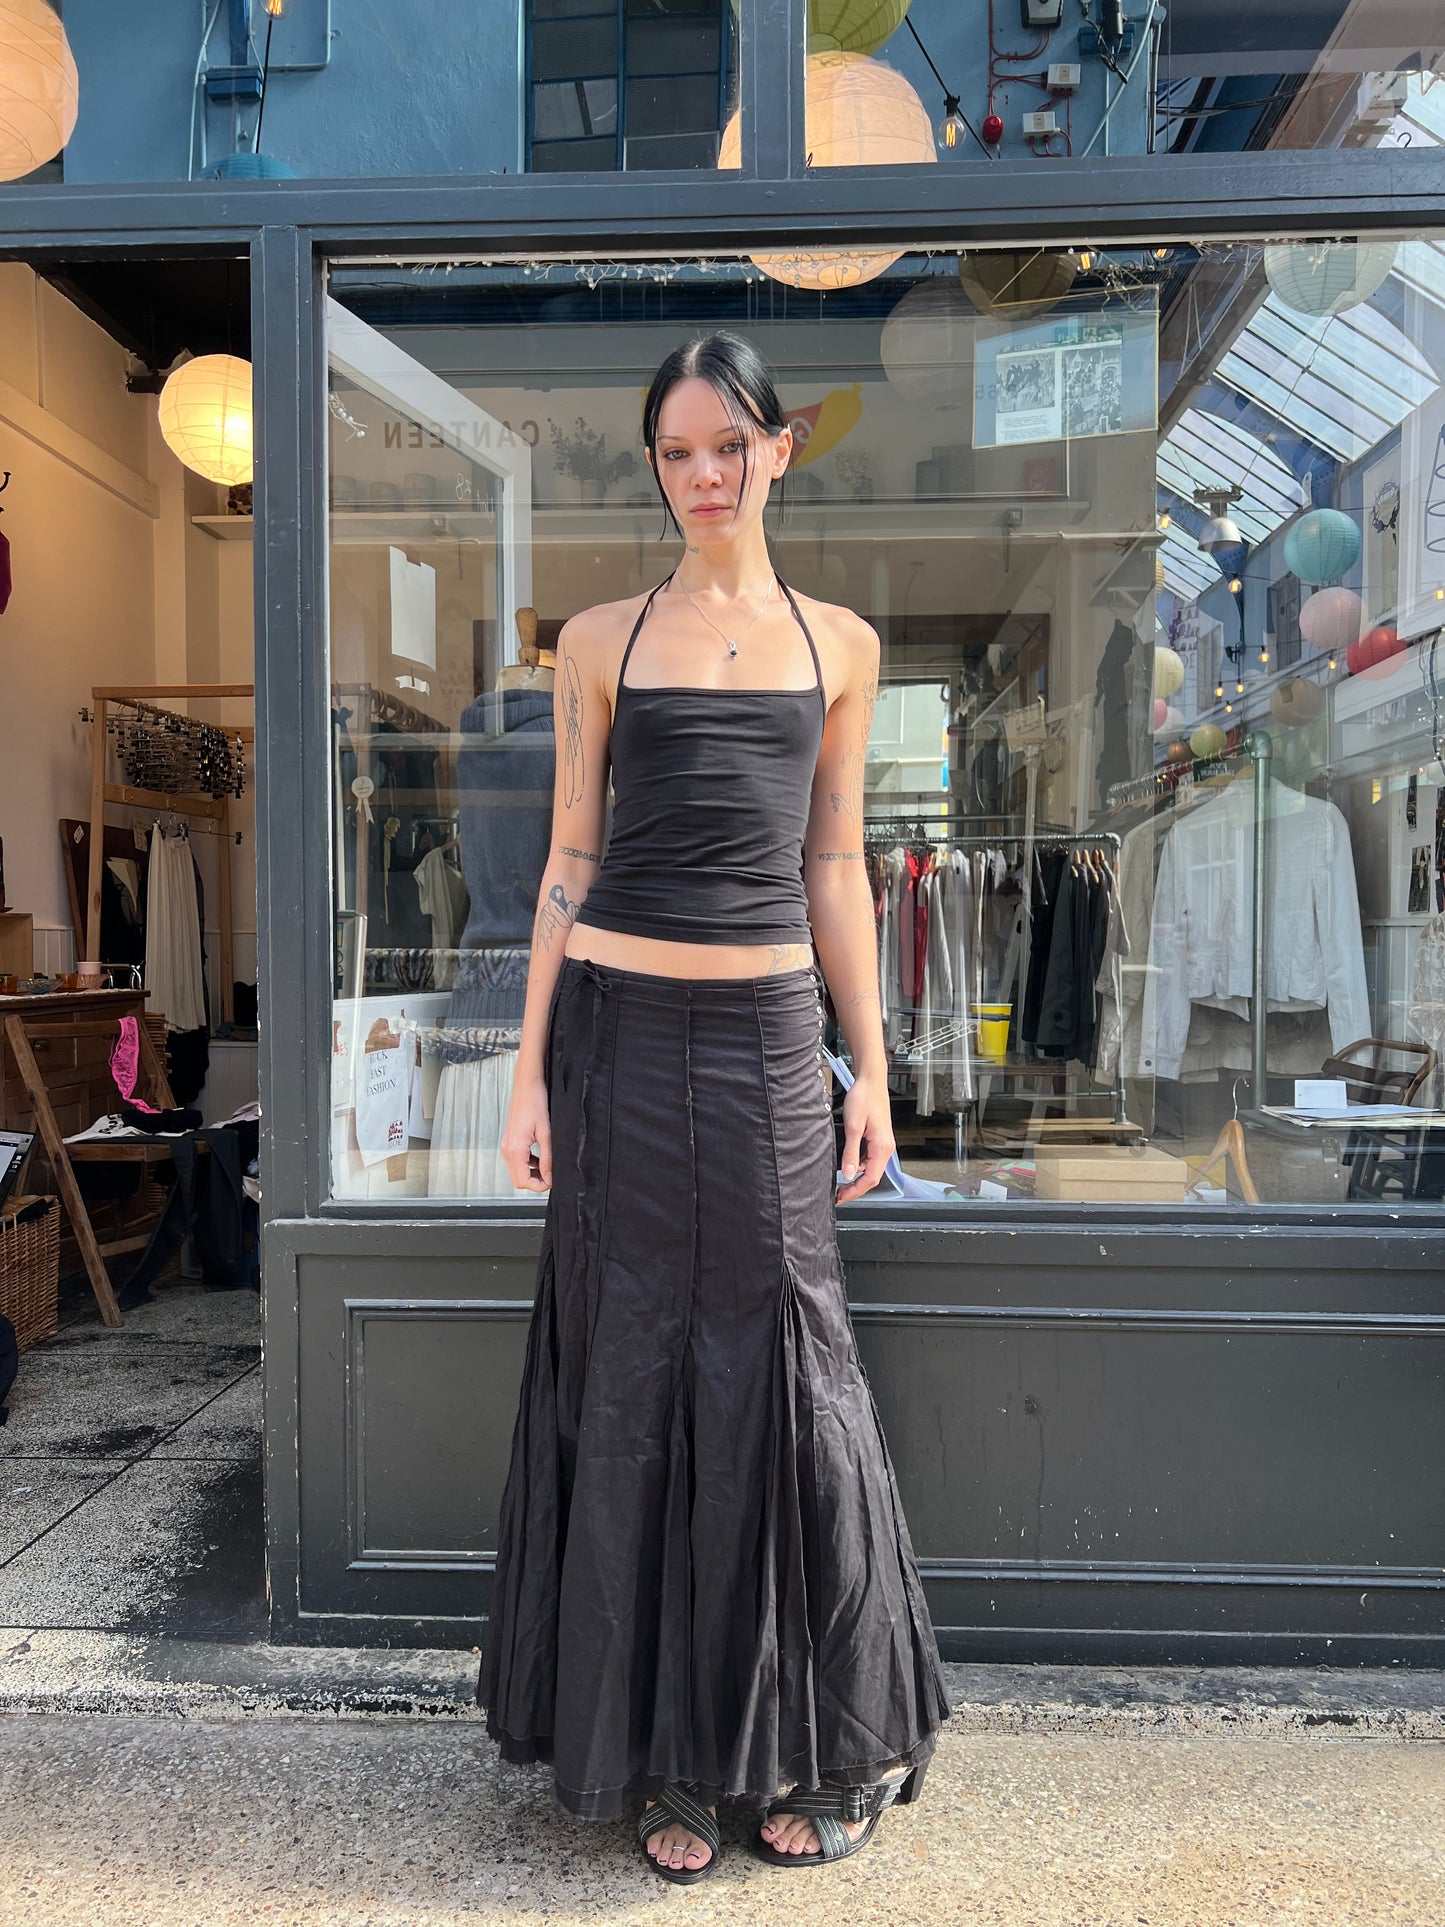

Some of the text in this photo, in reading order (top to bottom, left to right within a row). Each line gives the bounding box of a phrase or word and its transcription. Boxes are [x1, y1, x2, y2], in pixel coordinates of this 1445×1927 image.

[369, 1050, 388, 1064] FUCK
[370, 1066, 387, 1079] FAST
[366, 1078, 397, 1097] FASHION
